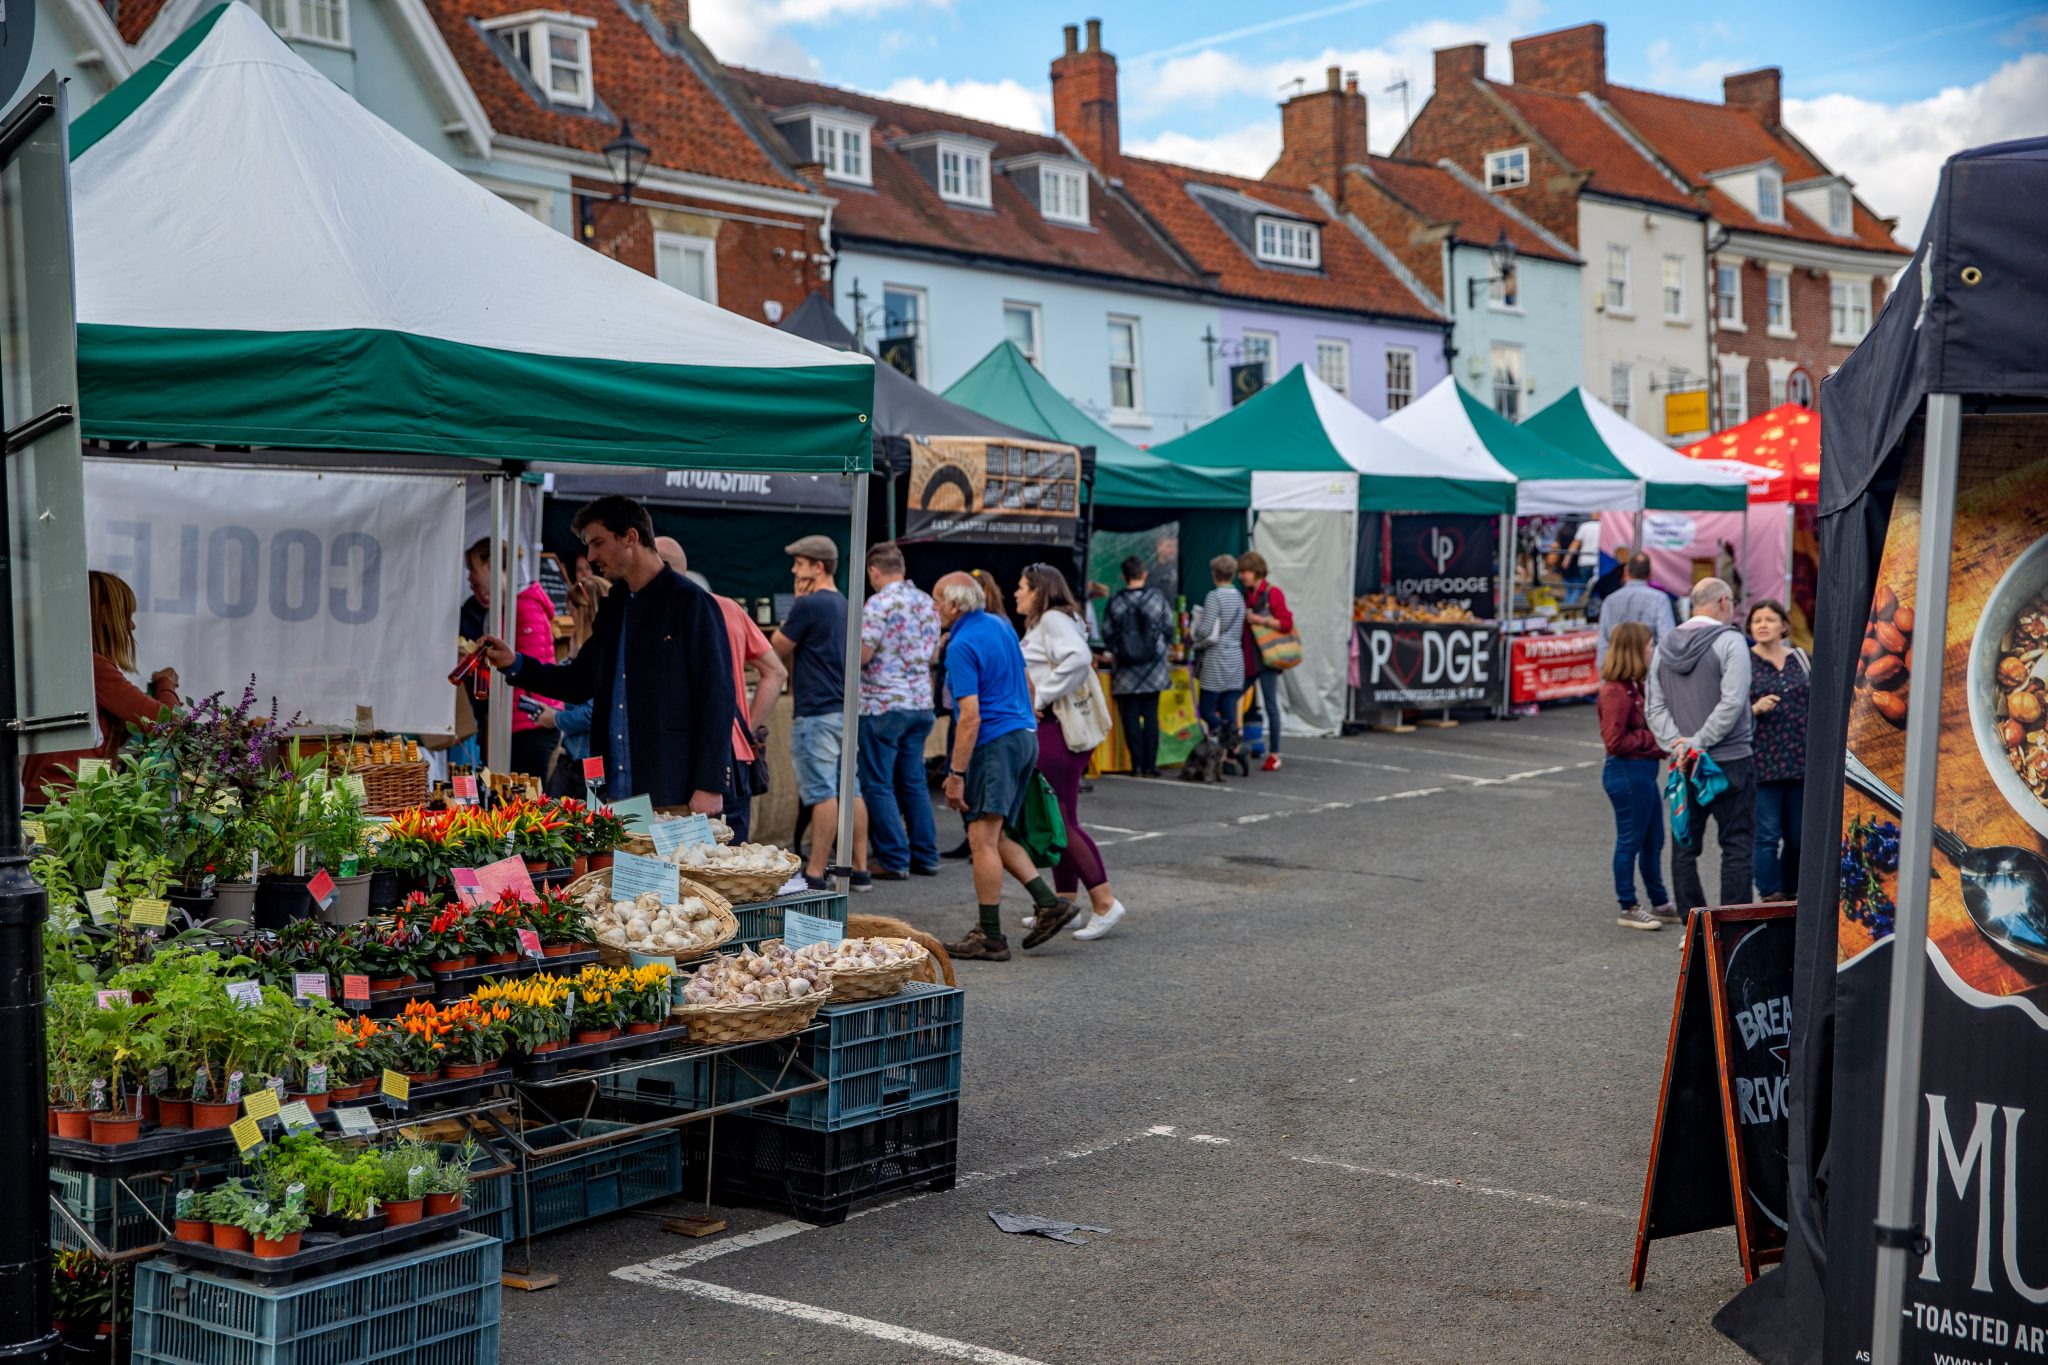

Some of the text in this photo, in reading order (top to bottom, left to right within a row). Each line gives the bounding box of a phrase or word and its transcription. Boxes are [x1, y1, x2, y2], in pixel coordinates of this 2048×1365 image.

[1396, 576, 1489, 594] LOVEPODGE
[1918, 1093, 2048, 1305] MU
[2014, 1323, 2048, 1355] AR
[1855, 1349, 1870, 1362] AS
